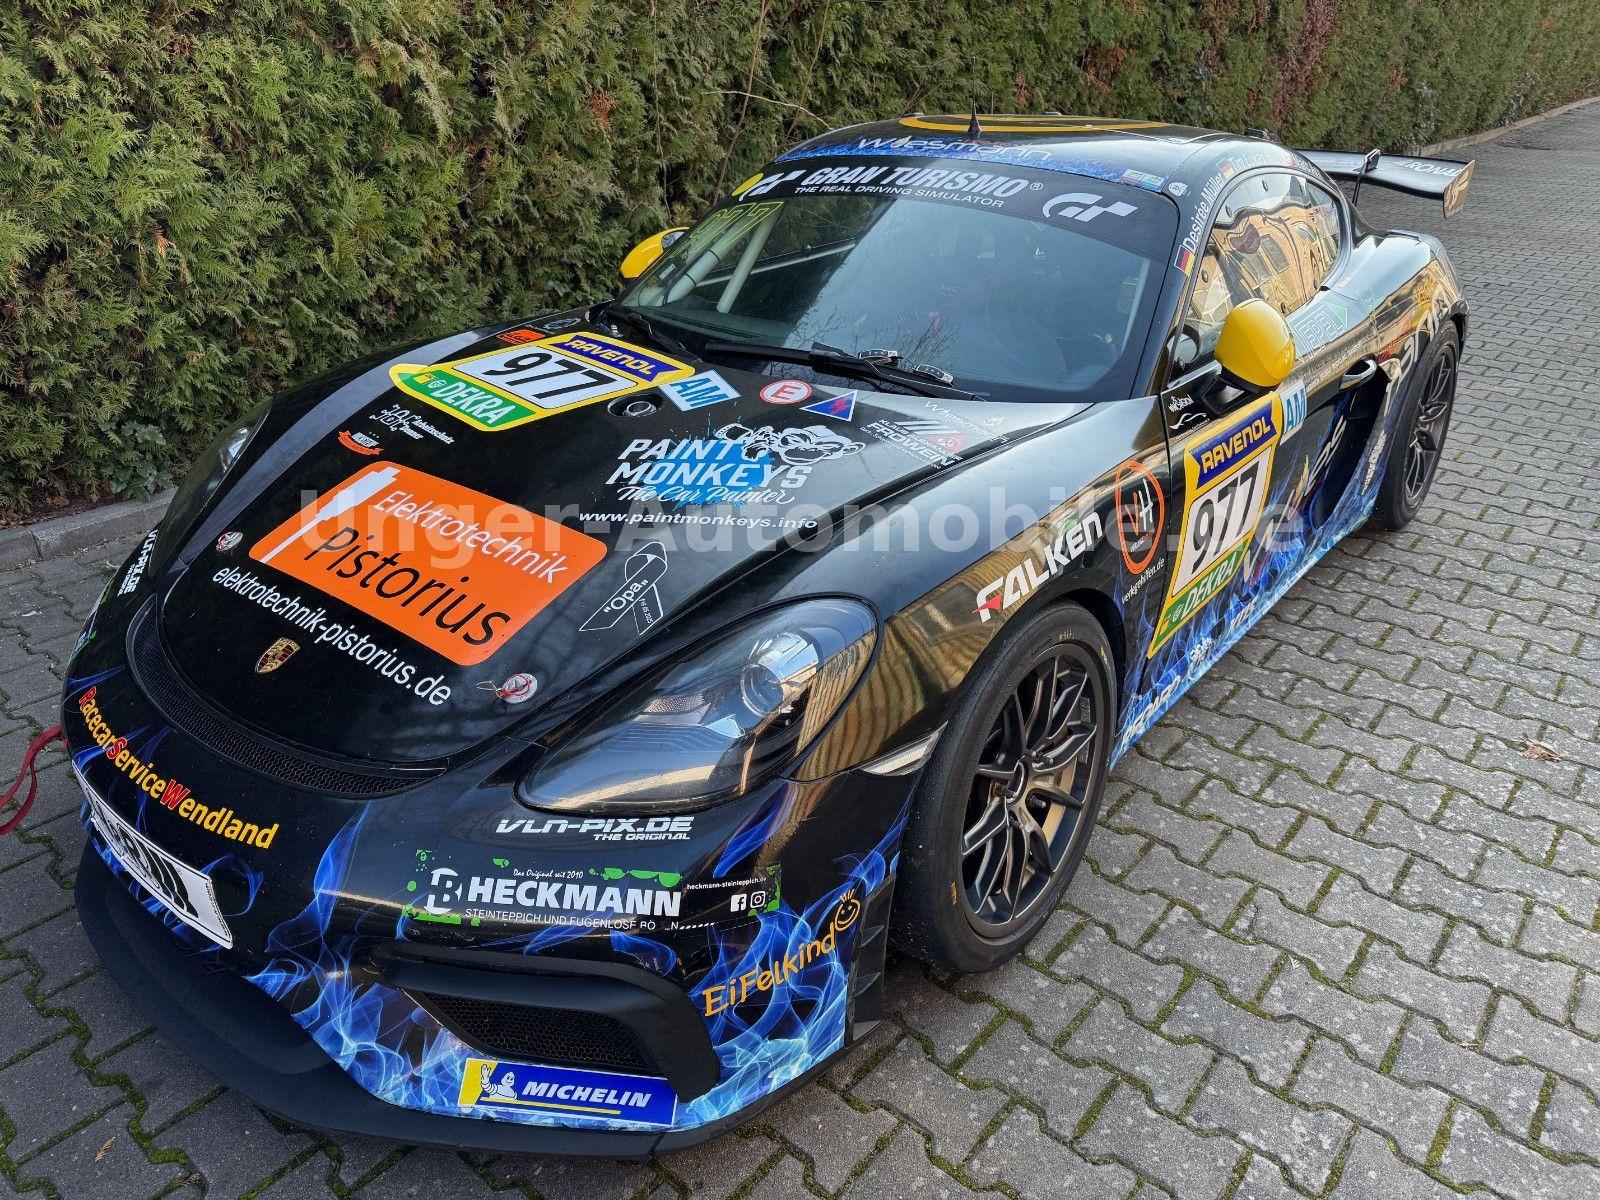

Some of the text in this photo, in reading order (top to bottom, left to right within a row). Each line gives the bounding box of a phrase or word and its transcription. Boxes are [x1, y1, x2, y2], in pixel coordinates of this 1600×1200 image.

[801, 166, 884, 187] GRAN
[819, 185, 852, 193] REAL
[855, 185, 913, 196] DRIVING
[914, 189, 1006, 209] SIMULATOR
[481, 352, 618, 400] 977
[564, 339, 659, 380] RAVENOL
[430, 381, 517, 424] DEKRA
[772, 385, 796, 399] E
[618, 438, 744, 461] PAINT
[867, 421, 964, 466] FROWEIN
[1202, 415, 1272, 474] RAVENOL
[605, 461, 813, 490] MONKEYS
[617, 484, 796, 505] The Car Painter
[579, 508, 818, 531] www.paintmonkeys.info
[1187, 460, 1260, 570] 977
[372, 490, 570, 585] Elektrotechnik
[974, 512, 1102, 621] FALKEN
[303, 526, 513, 646] Pistorius
[1181, 551, 1238, 620] DEKRA
[213, 566, 452, 707] elektrotechnik-pistorius.de
[496, 816, 695, 835] VLN-PIX.DE
[593, 832, 691, 842] THE ORIGINAL
[513, 868, 584, 881] Das Original seit 2010
[467, 876, 682, 917] HECKMANN
[465, 908, 541, 924] STEINTEPPICH
[544, 915, 567, 926] UND
[521, 1079, 652, 1108] MICHELIN
